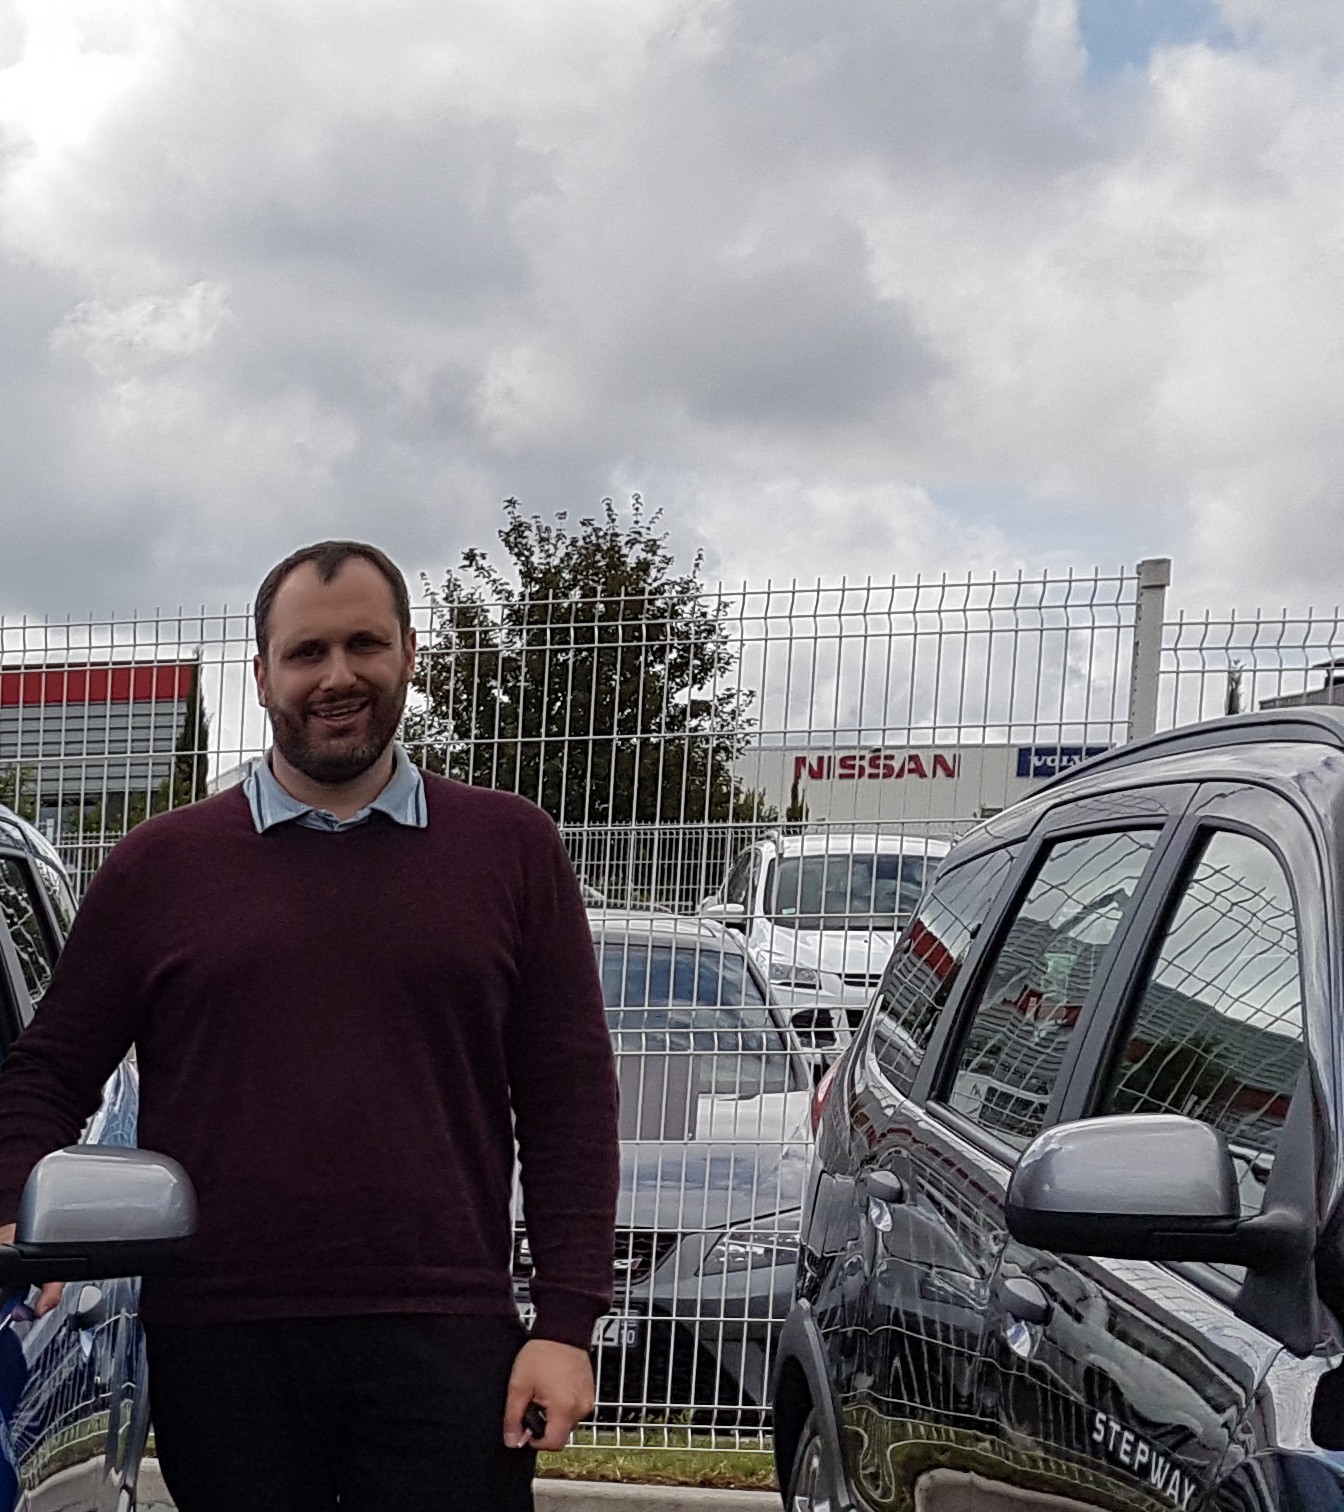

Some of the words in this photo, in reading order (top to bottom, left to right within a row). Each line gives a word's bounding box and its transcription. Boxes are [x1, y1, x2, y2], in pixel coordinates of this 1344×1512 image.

[794, 753, 960, 780] NISSAN
[1030, 755, 1089, 768] VOLV
[1091, 1411, 1196, 1511] STEPWAY
